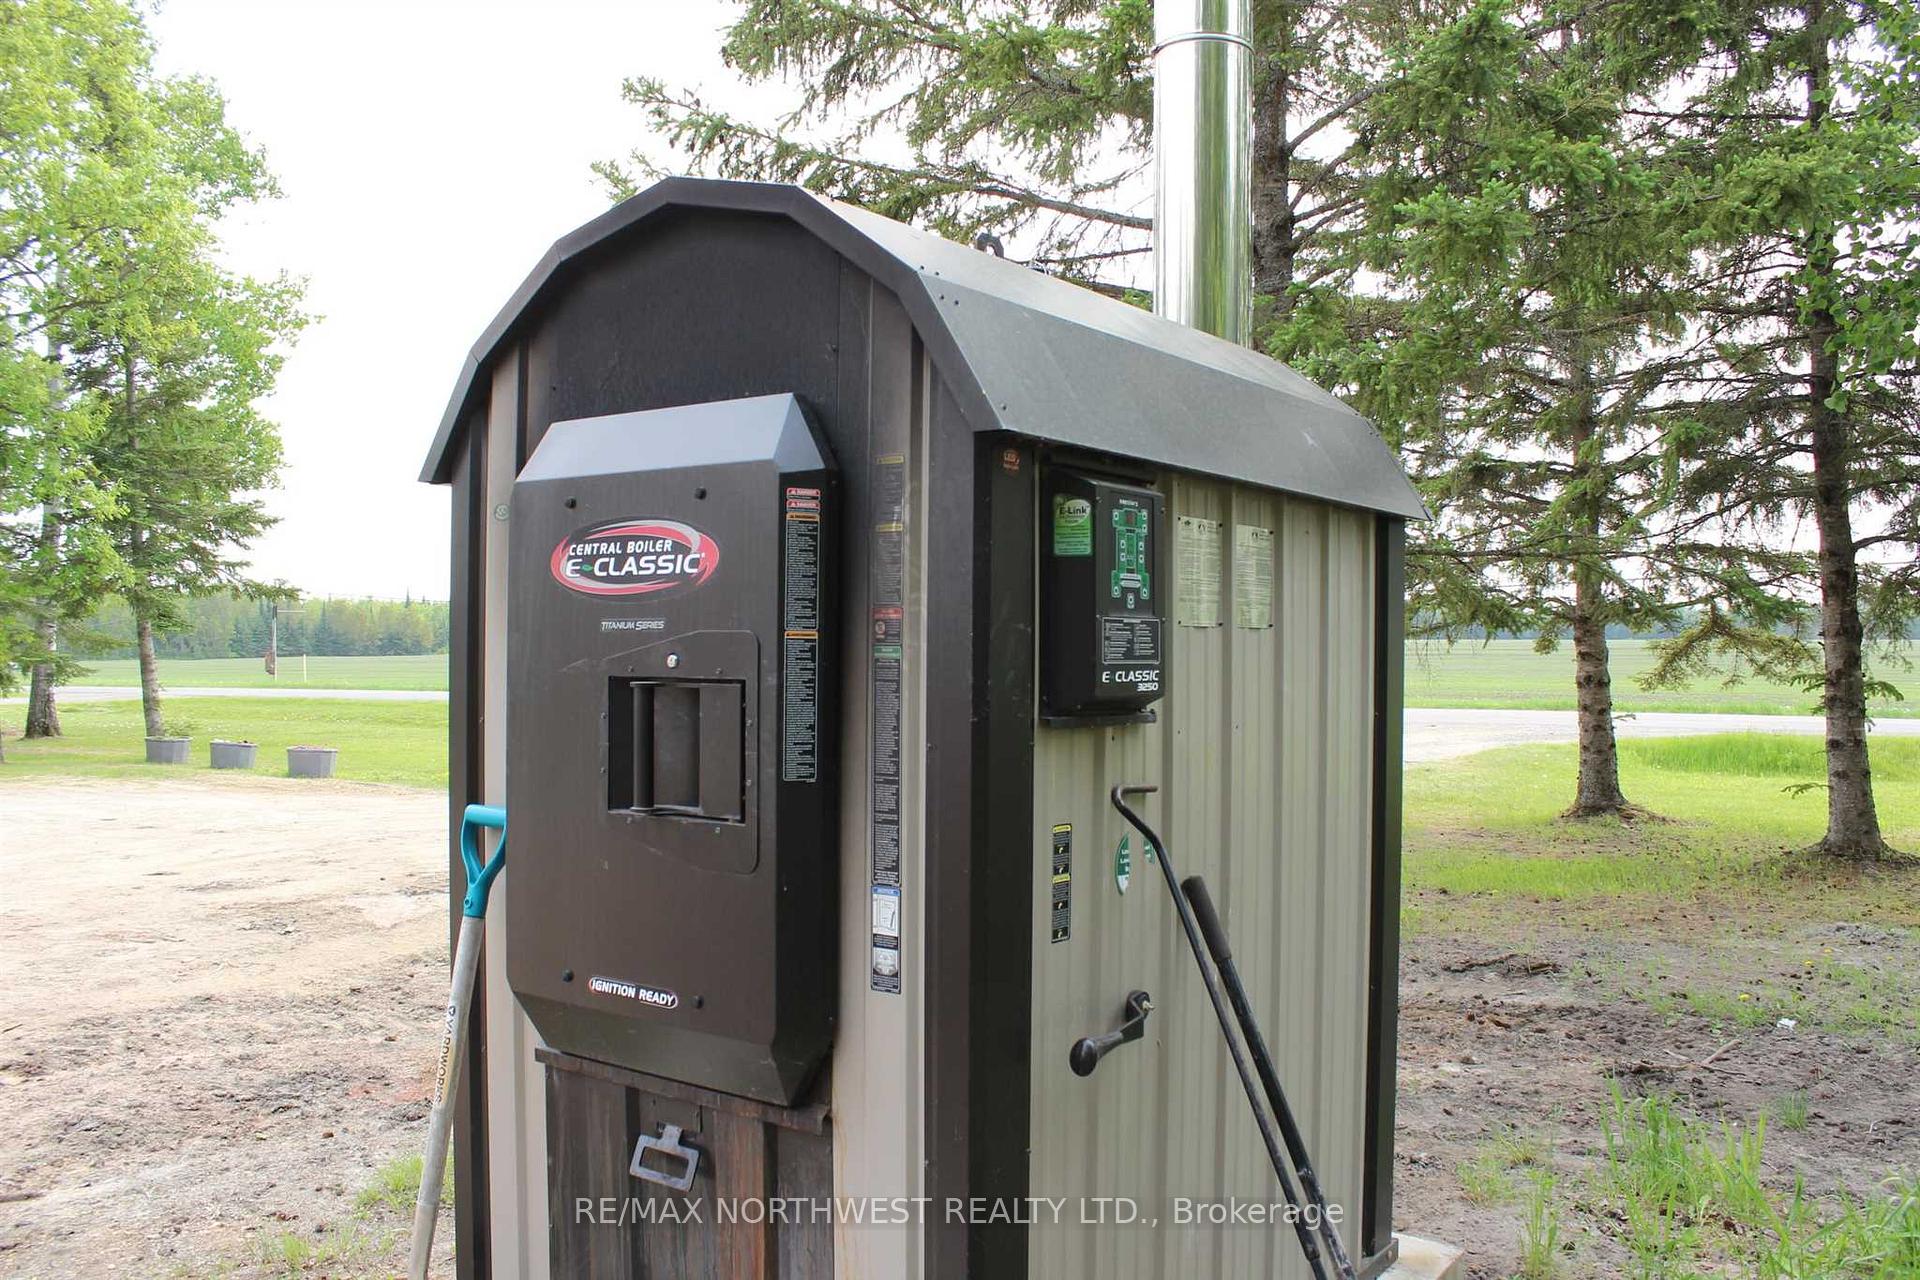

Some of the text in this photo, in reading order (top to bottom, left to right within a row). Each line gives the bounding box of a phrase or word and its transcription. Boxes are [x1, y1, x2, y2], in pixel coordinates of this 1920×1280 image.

[569, 539, 673, 556] CENTRAL BOILER
[601, 620, 664, 631] TITANIUM SERIES
[1137, 682, 1159, 692] 3250
[592, 979, 674, 1006] IGNITION READY
